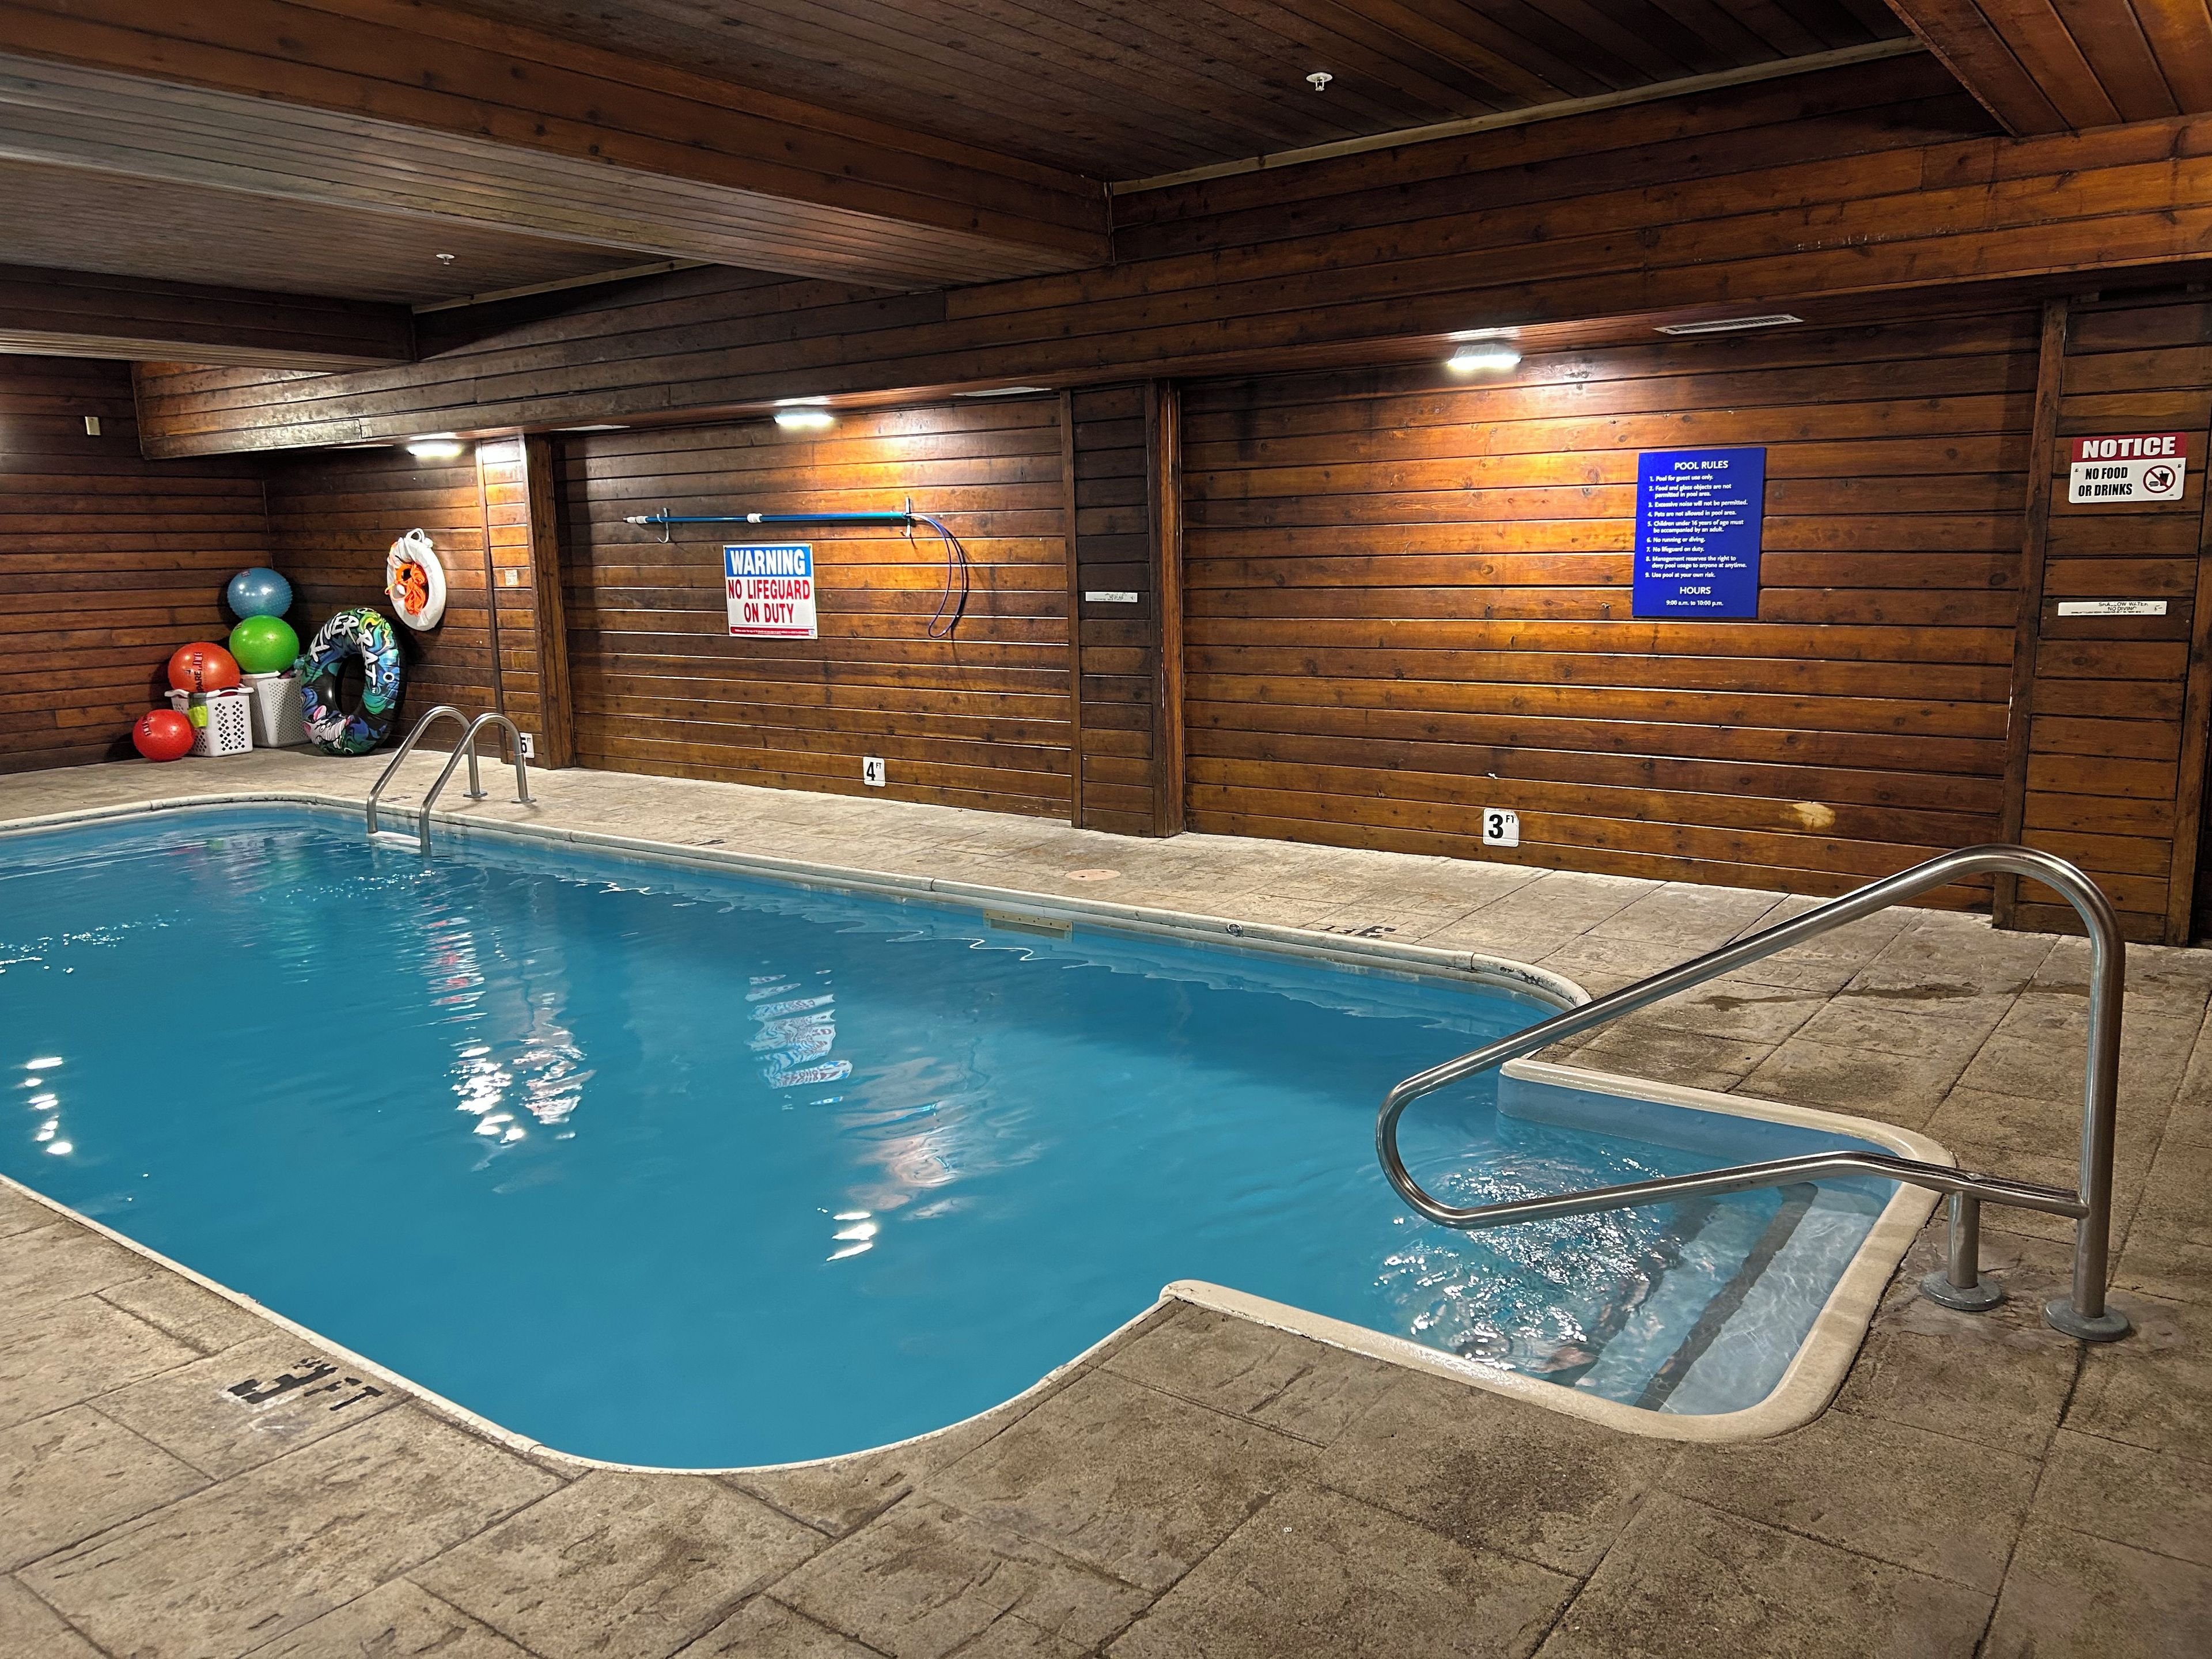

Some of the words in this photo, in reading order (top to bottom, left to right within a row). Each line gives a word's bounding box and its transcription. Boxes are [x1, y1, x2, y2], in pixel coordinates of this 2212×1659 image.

[2082, 436, 2176, 459] NOTICE
[1675, 462, 1699, 470] POOL
[1702, 461, 1728, 469] RULES
[2085, 468, 2099, 480] NO
[2101, 467, 2128, 479] FOOD
[2078, 484, 2092, 497] OR
[2094, 483, 2133, 495] DRINKS
[730, 549, 805, 575] WARNING
[728, 579, 742, 599] NO
[748, 579, 810, 600] LIFEGUARD
[1680, 586, 1711, 594] HOURS
[744, 603, 759, 623] ON
[764, 604, 794, 623] DUTY
[356, 629, 378, 686] RAT
[866, 762, 876, 781] 4
[1488, 815, 1503, 839] 3
